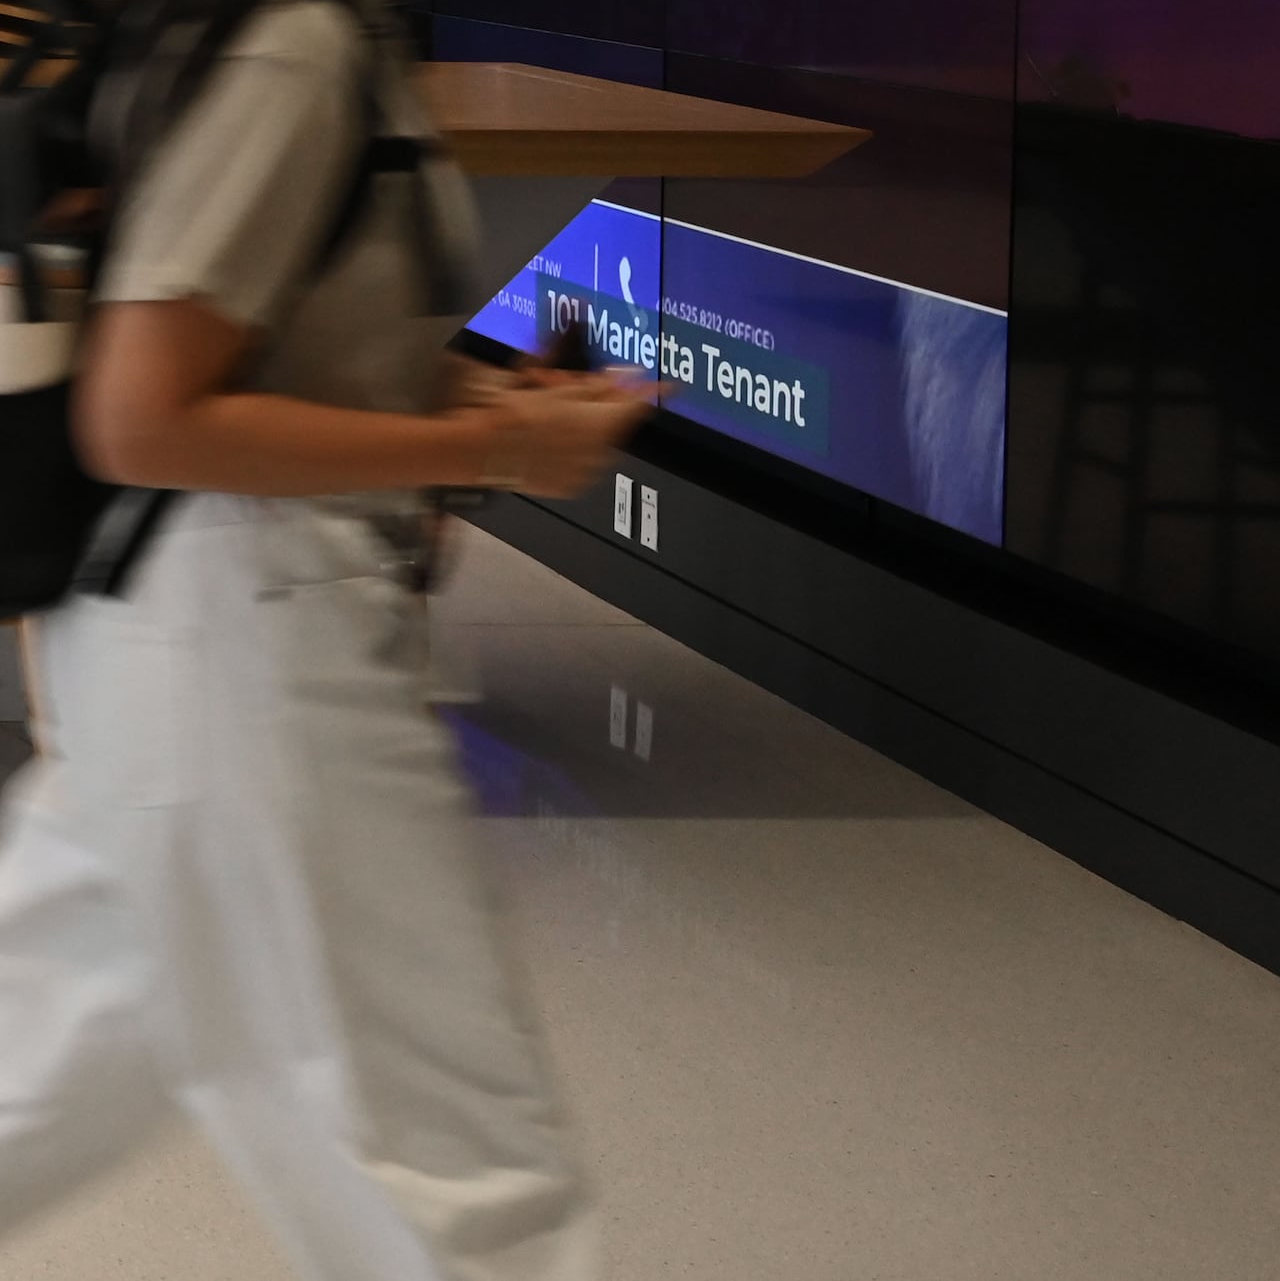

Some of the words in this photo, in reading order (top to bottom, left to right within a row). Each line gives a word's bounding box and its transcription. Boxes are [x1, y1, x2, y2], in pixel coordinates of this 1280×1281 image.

[545, 259, 562, 278] NW
[587, 304, 695, 384] Marietta
[702, 343, 806, 427] Tenant
